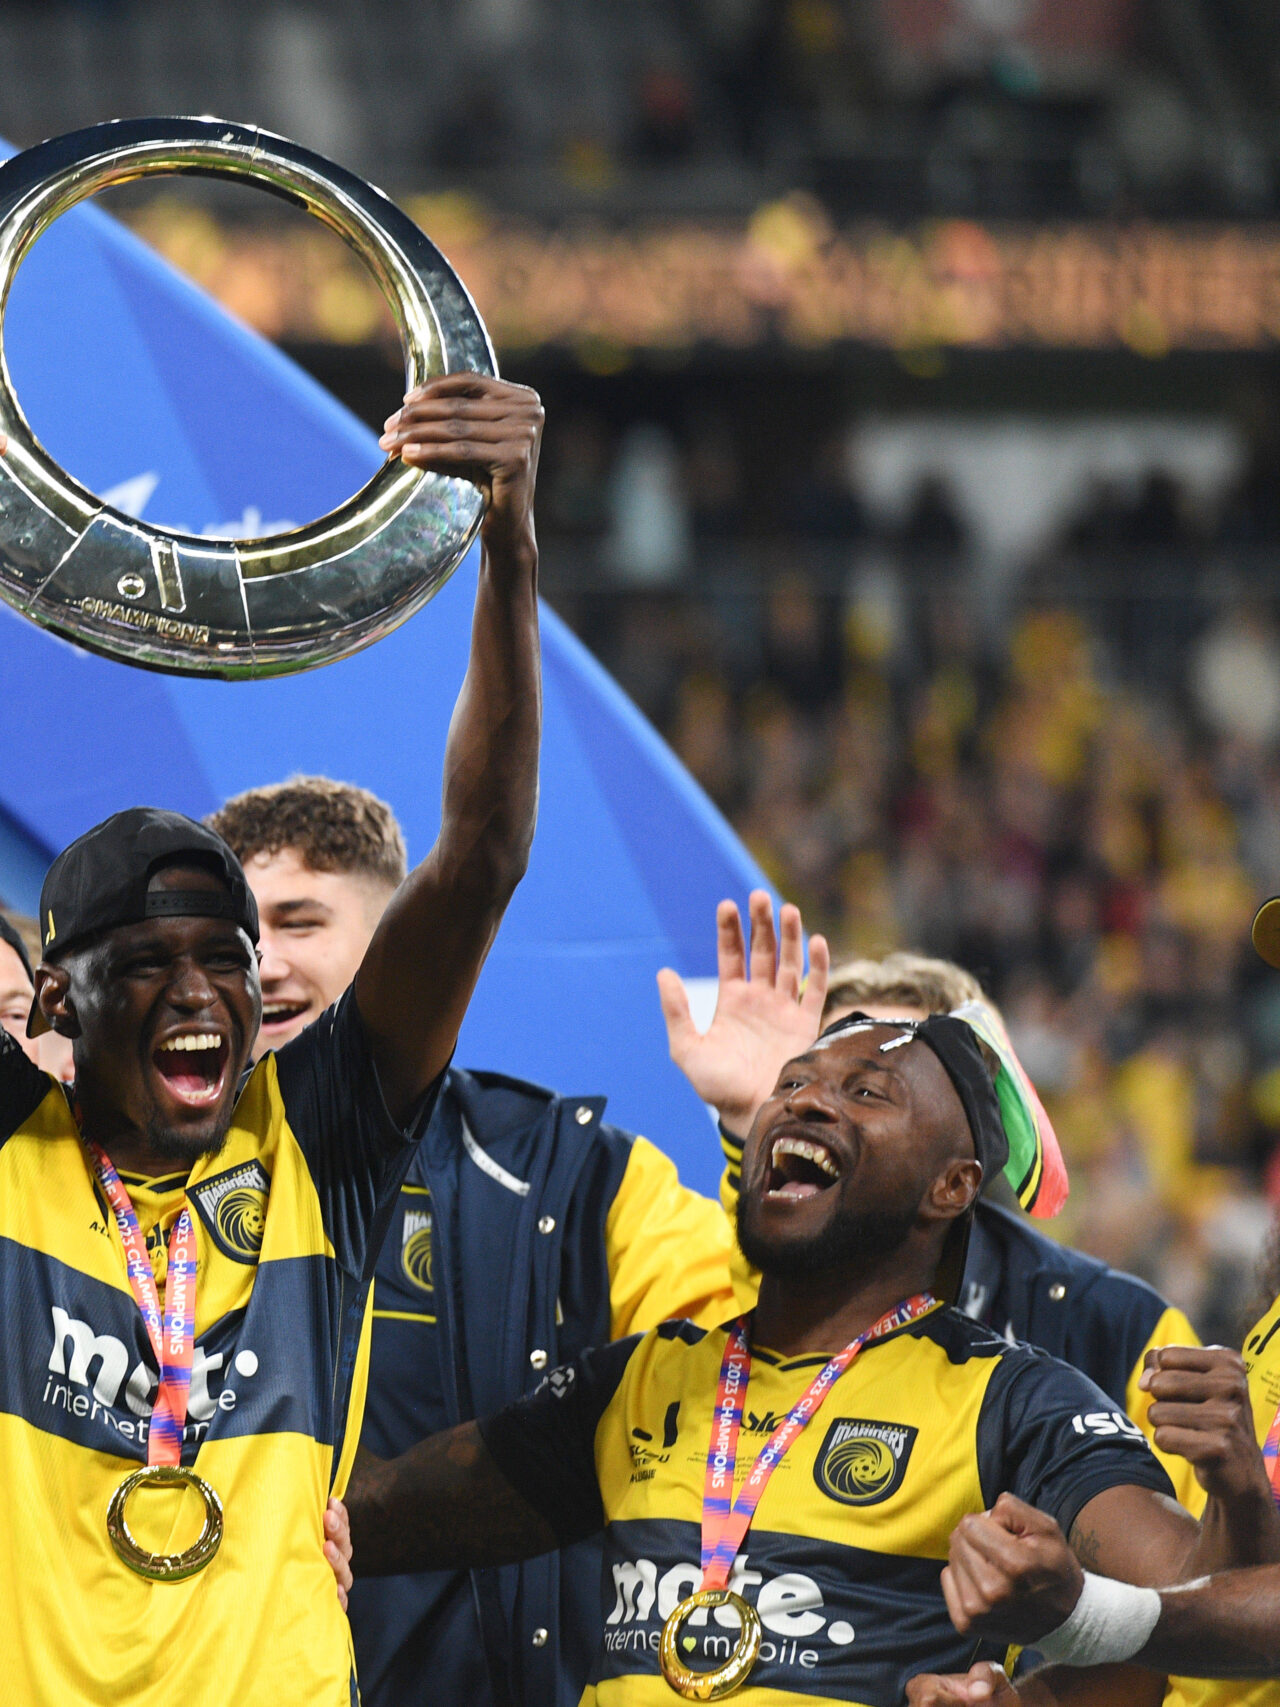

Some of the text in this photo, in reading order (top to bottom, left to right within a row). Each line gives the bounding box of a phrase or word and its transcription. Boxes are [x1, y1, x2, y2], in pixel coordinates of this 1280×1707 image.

[169, 1248, 188, 1355] CHAMPIONS
[42, 1374, 149, 1444] internet
[724, 1362, 742, 1395] 2023
[810, 1363, 839, 1396] 2023
[712, 1397, 736, 1488] CHAMPIONS
[750, 1397, 813, 1486] CHAMPIONS
[828, 1424, 908, 1460] MARINERS
[1072, 1412, 1144, 1436] ISU
[606, 1554, 856, 1645] mate.
